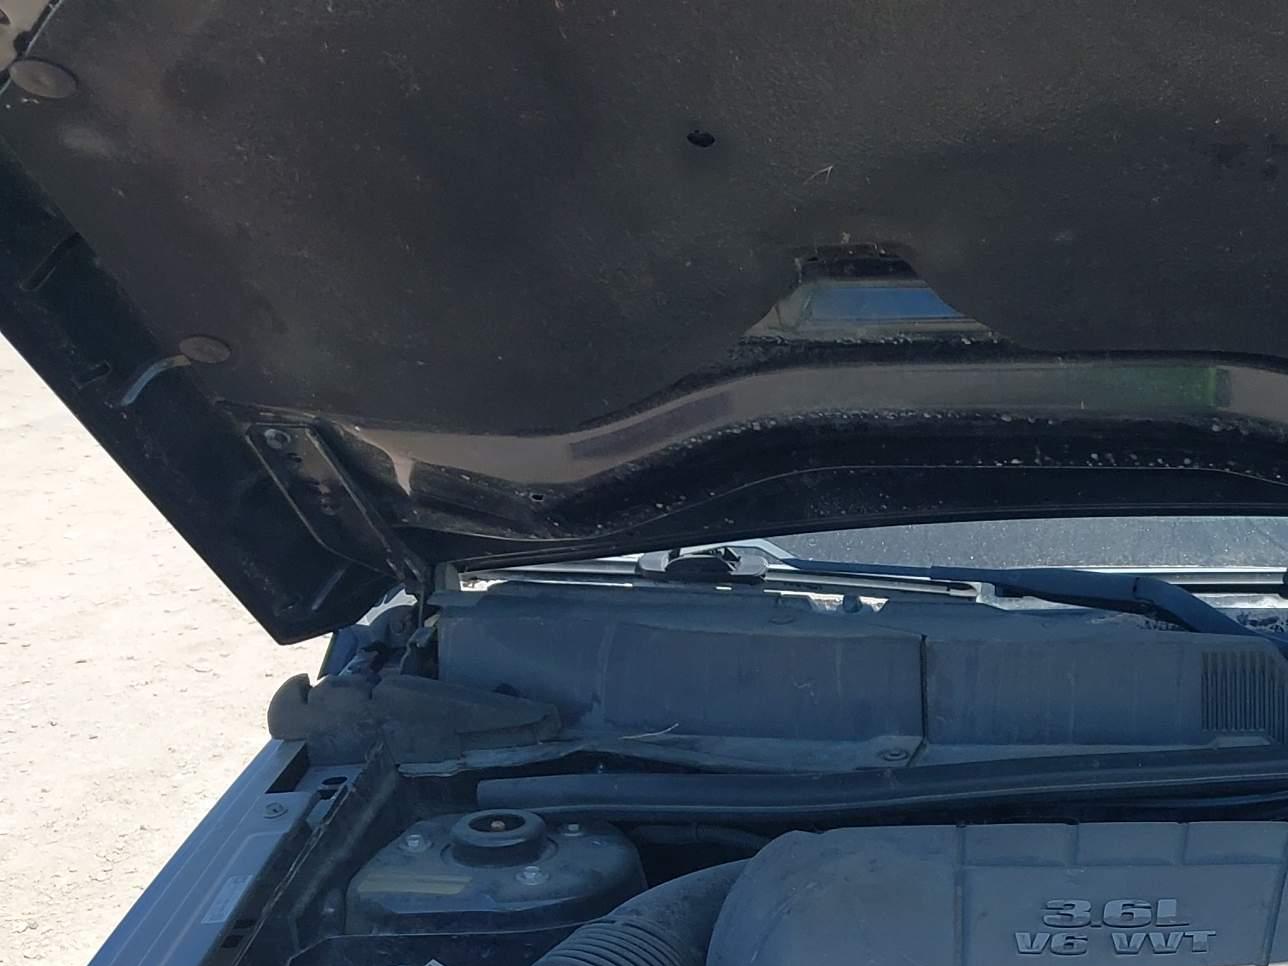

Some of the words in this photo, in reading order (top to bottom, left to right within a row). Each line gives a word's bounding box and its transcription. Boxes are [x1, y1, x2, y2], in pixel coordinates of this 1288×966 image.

[1042, 898, 1190, 929] 3.6L
[1014, 931, 1089, 956] V6
[1110, 930, 1217, 956] VVT
